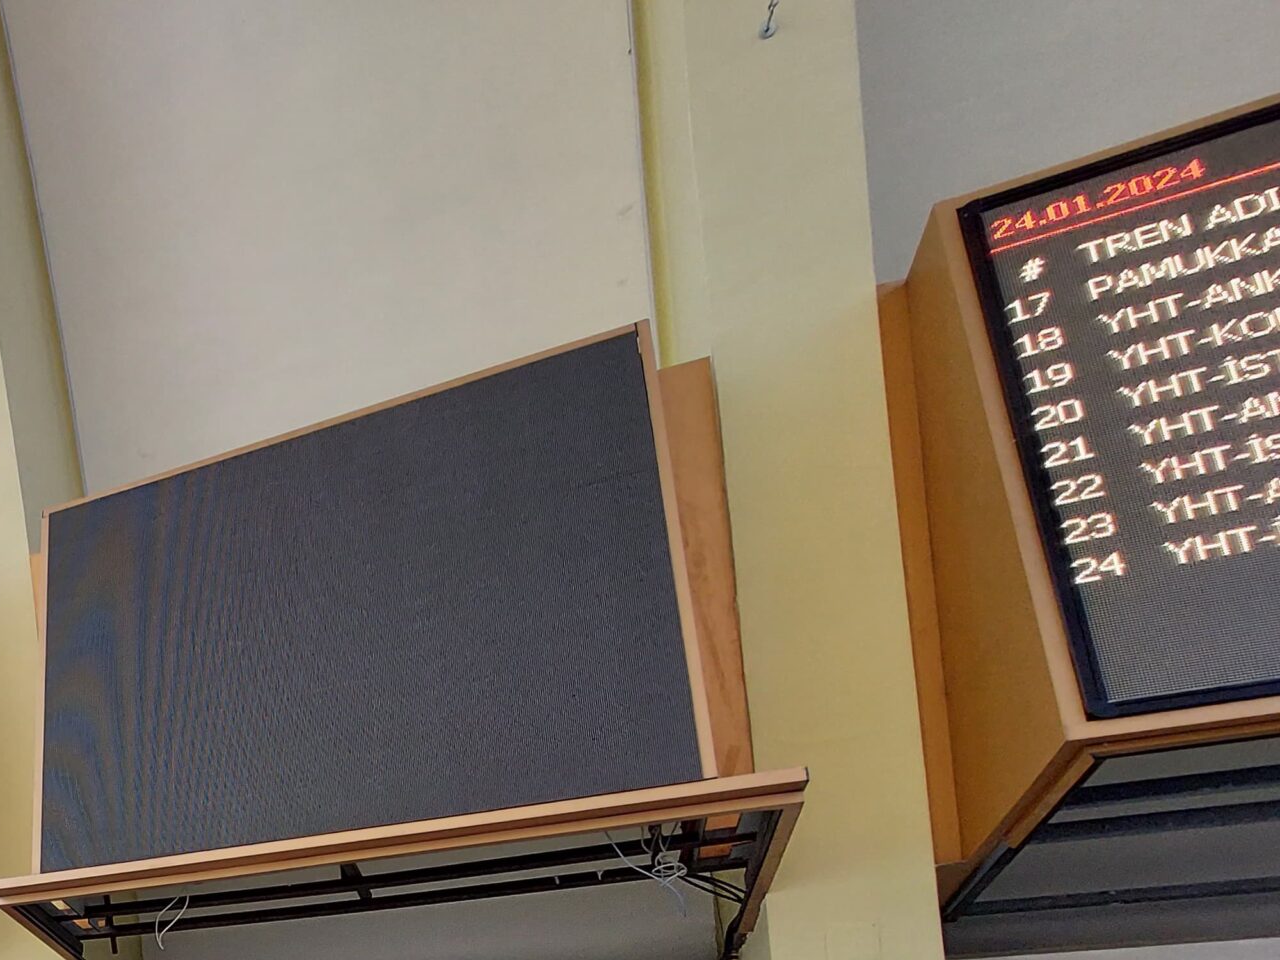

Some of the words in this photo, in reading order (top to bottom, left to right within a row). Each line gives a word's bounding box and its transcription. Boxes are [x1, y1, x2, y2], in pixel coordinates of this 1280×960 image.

[990, 158, 1206, 240] 24.01.2024
[1020, 256, 1047, 283] #
[1076, 213, 1194, 264] TREN
[1204, 187, 1280, 231] ADI
[1004, 291, 1052, 325] 17
[1013, 326, 1064, 360] 18
[1022, 362, 1075, 395] 19
[1106, 307, 1280, 370] YHT-KO
[1031, 399, 1084, 431] 20
[1040, 435, 1095, 469] 21
[1050, 473, 1106, 507] 22
[1060, 512, 1117, 545] 23
[1070, 551, 1126, 585] 24
